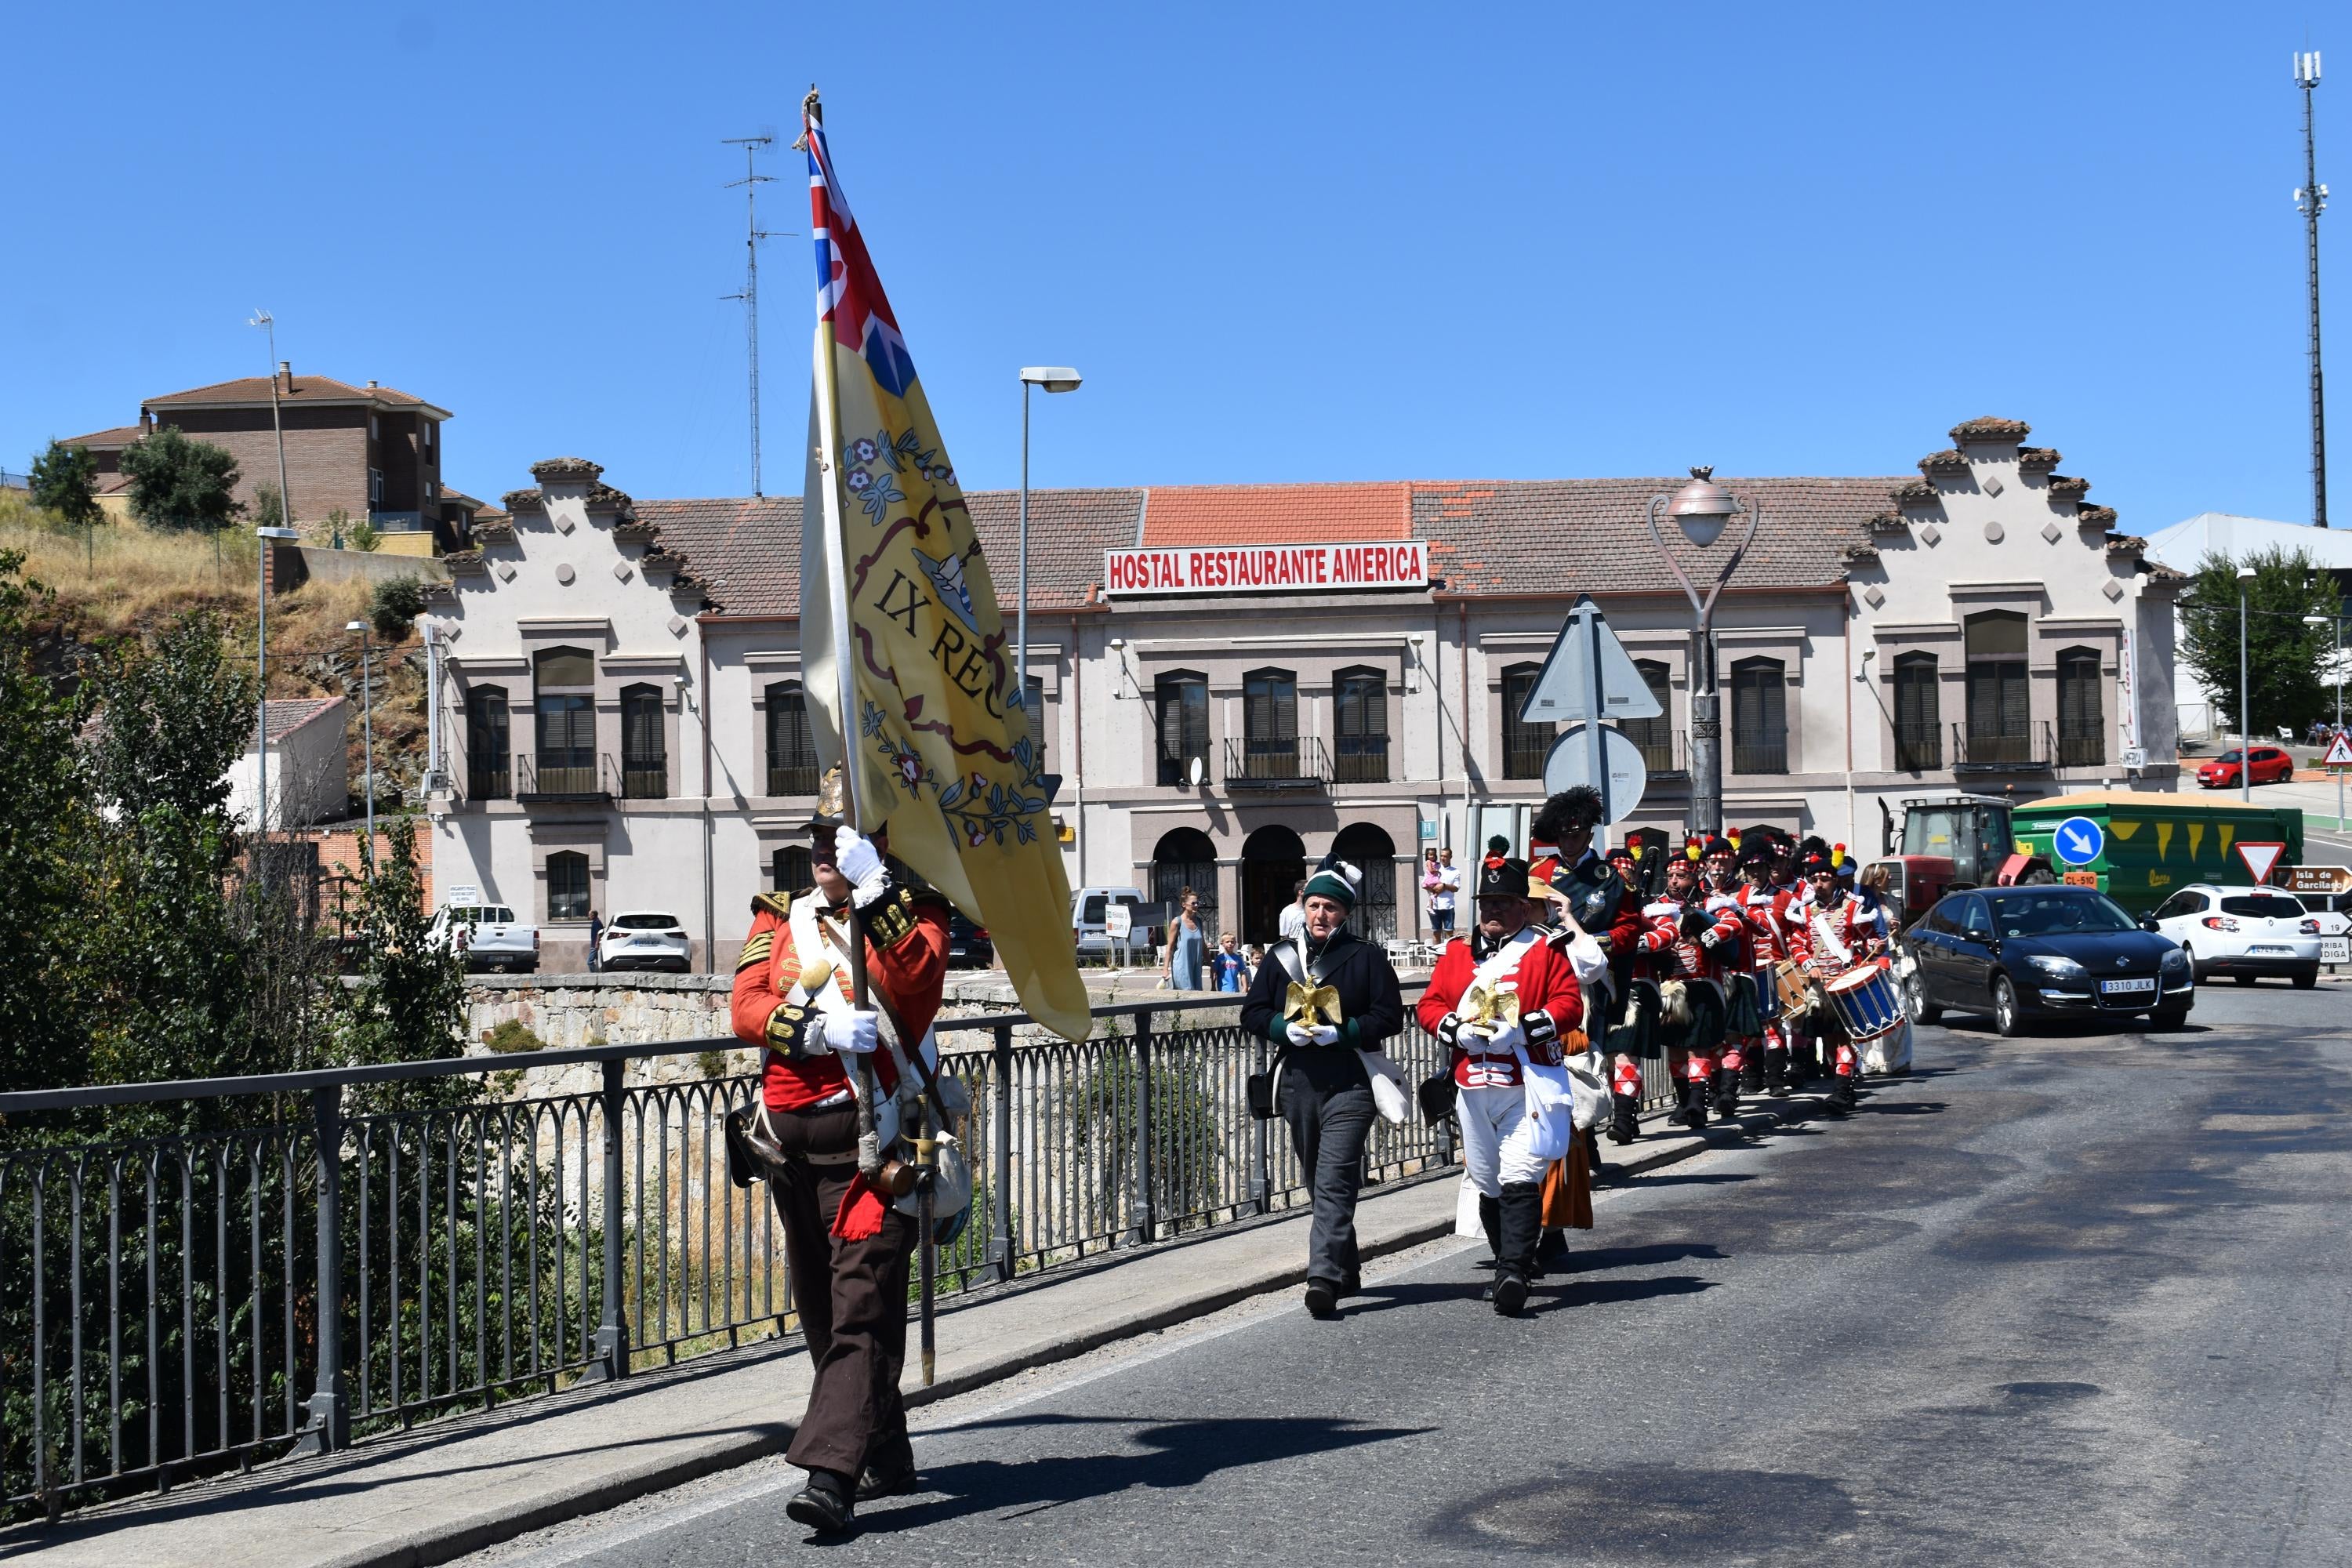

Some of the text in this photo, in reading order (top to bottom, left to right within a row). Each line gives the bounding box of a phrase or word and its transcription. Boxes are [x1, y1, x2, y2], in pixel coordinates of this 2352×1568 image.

[1110, 546, 1421, 589] HOSTAL RESTAURANTE AMERICA
[873, 568, 931, 638] IX
[2065, 877, 2094, 885] CL-510
[2296, 880, 2343, 889] Garcilaso
[2108, 980, 2151, 991] 3310 JLK
